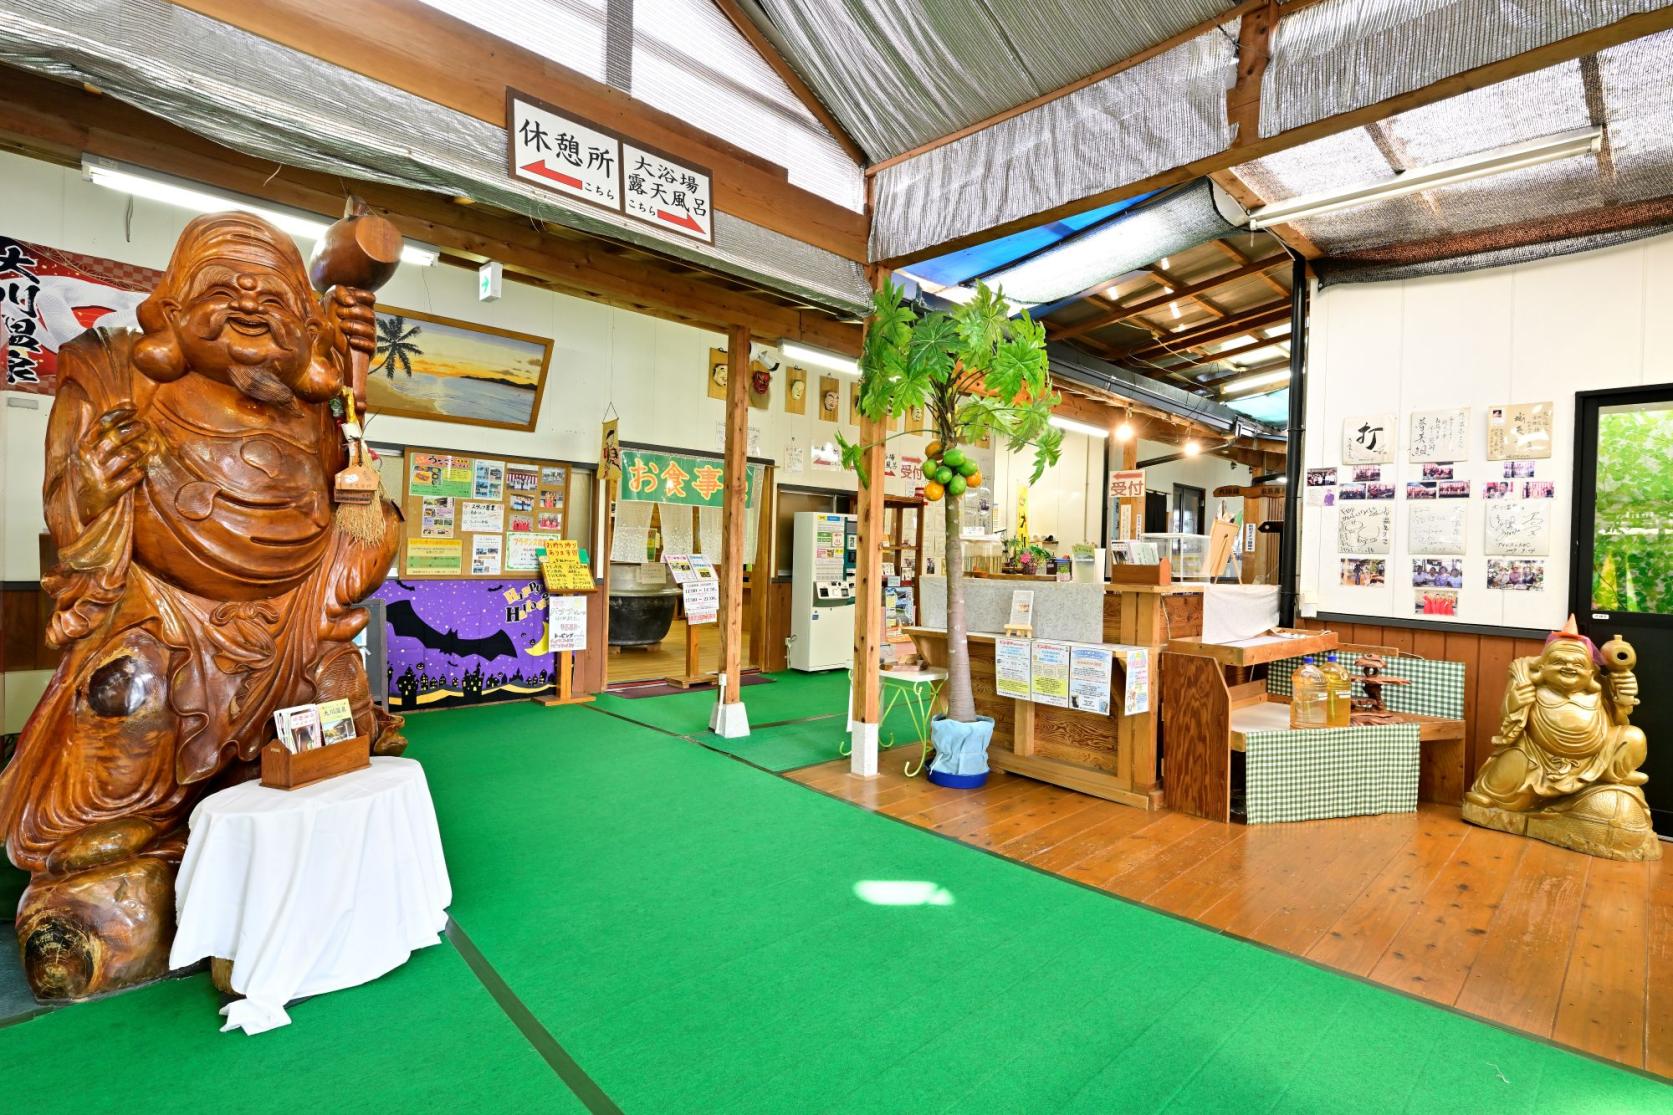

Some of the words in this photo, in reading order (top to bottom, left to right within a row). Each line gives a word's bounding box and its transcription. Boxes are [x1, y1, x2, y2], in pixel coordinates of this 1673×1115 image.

[518, 119, 615, 179] 休憩所
[634, 154, 699, 195] 大浴場
[584, 181, 615, 201] こちら
[628, 173, 707, 217] 露天風呂
[628, 199, 656, 217] こちら
[628, 457, 748, 501] お食事
[900, 464, 923, 481] 受付
[1110, 480, 1144, 497] 受付
